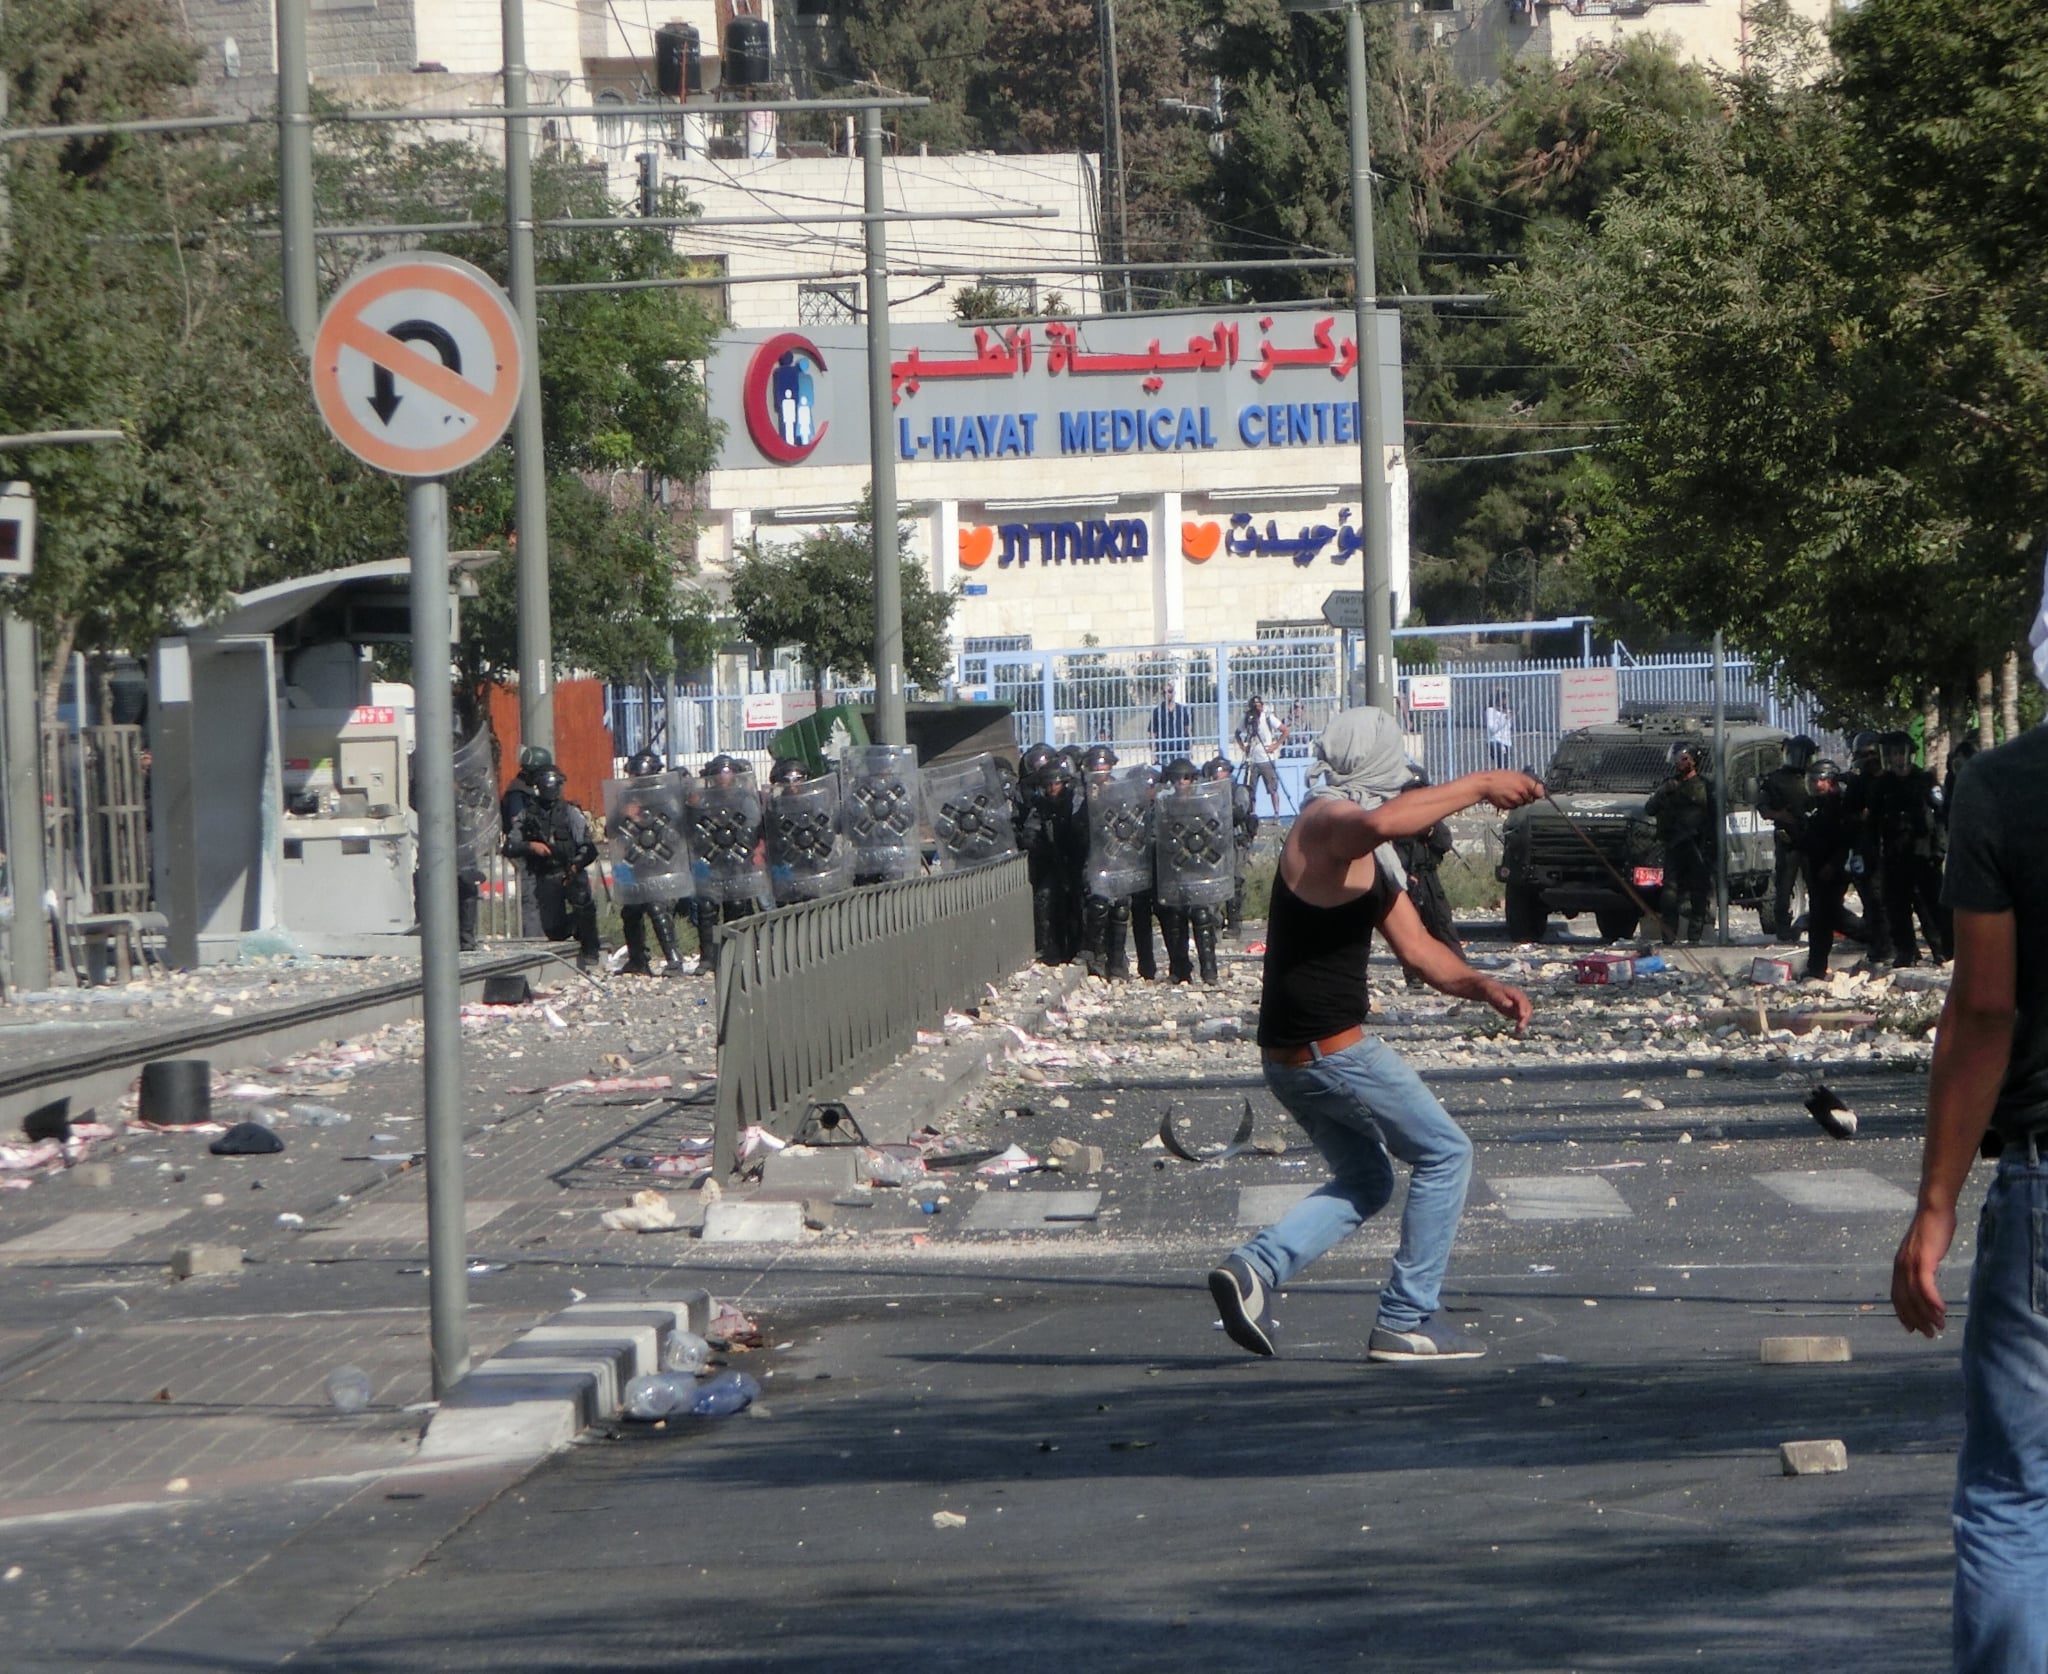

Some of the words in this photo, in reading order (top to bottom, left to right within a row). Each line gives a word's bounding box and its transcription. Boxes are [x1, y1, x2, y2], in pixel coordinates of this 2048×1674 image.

[891, 327, 1032, 408] الطب
[1045, 321, 1239, 396] الحياة
[1250, 316, 1359, 384] ركز
[899, 412, 1038, 460] L-HAYAT
[1060, 406, 1218, 455] MEDICAL
[997, 518, 1149, 569] מאוחדת
[1225, 507, 1364, 568] ؤحيدت
